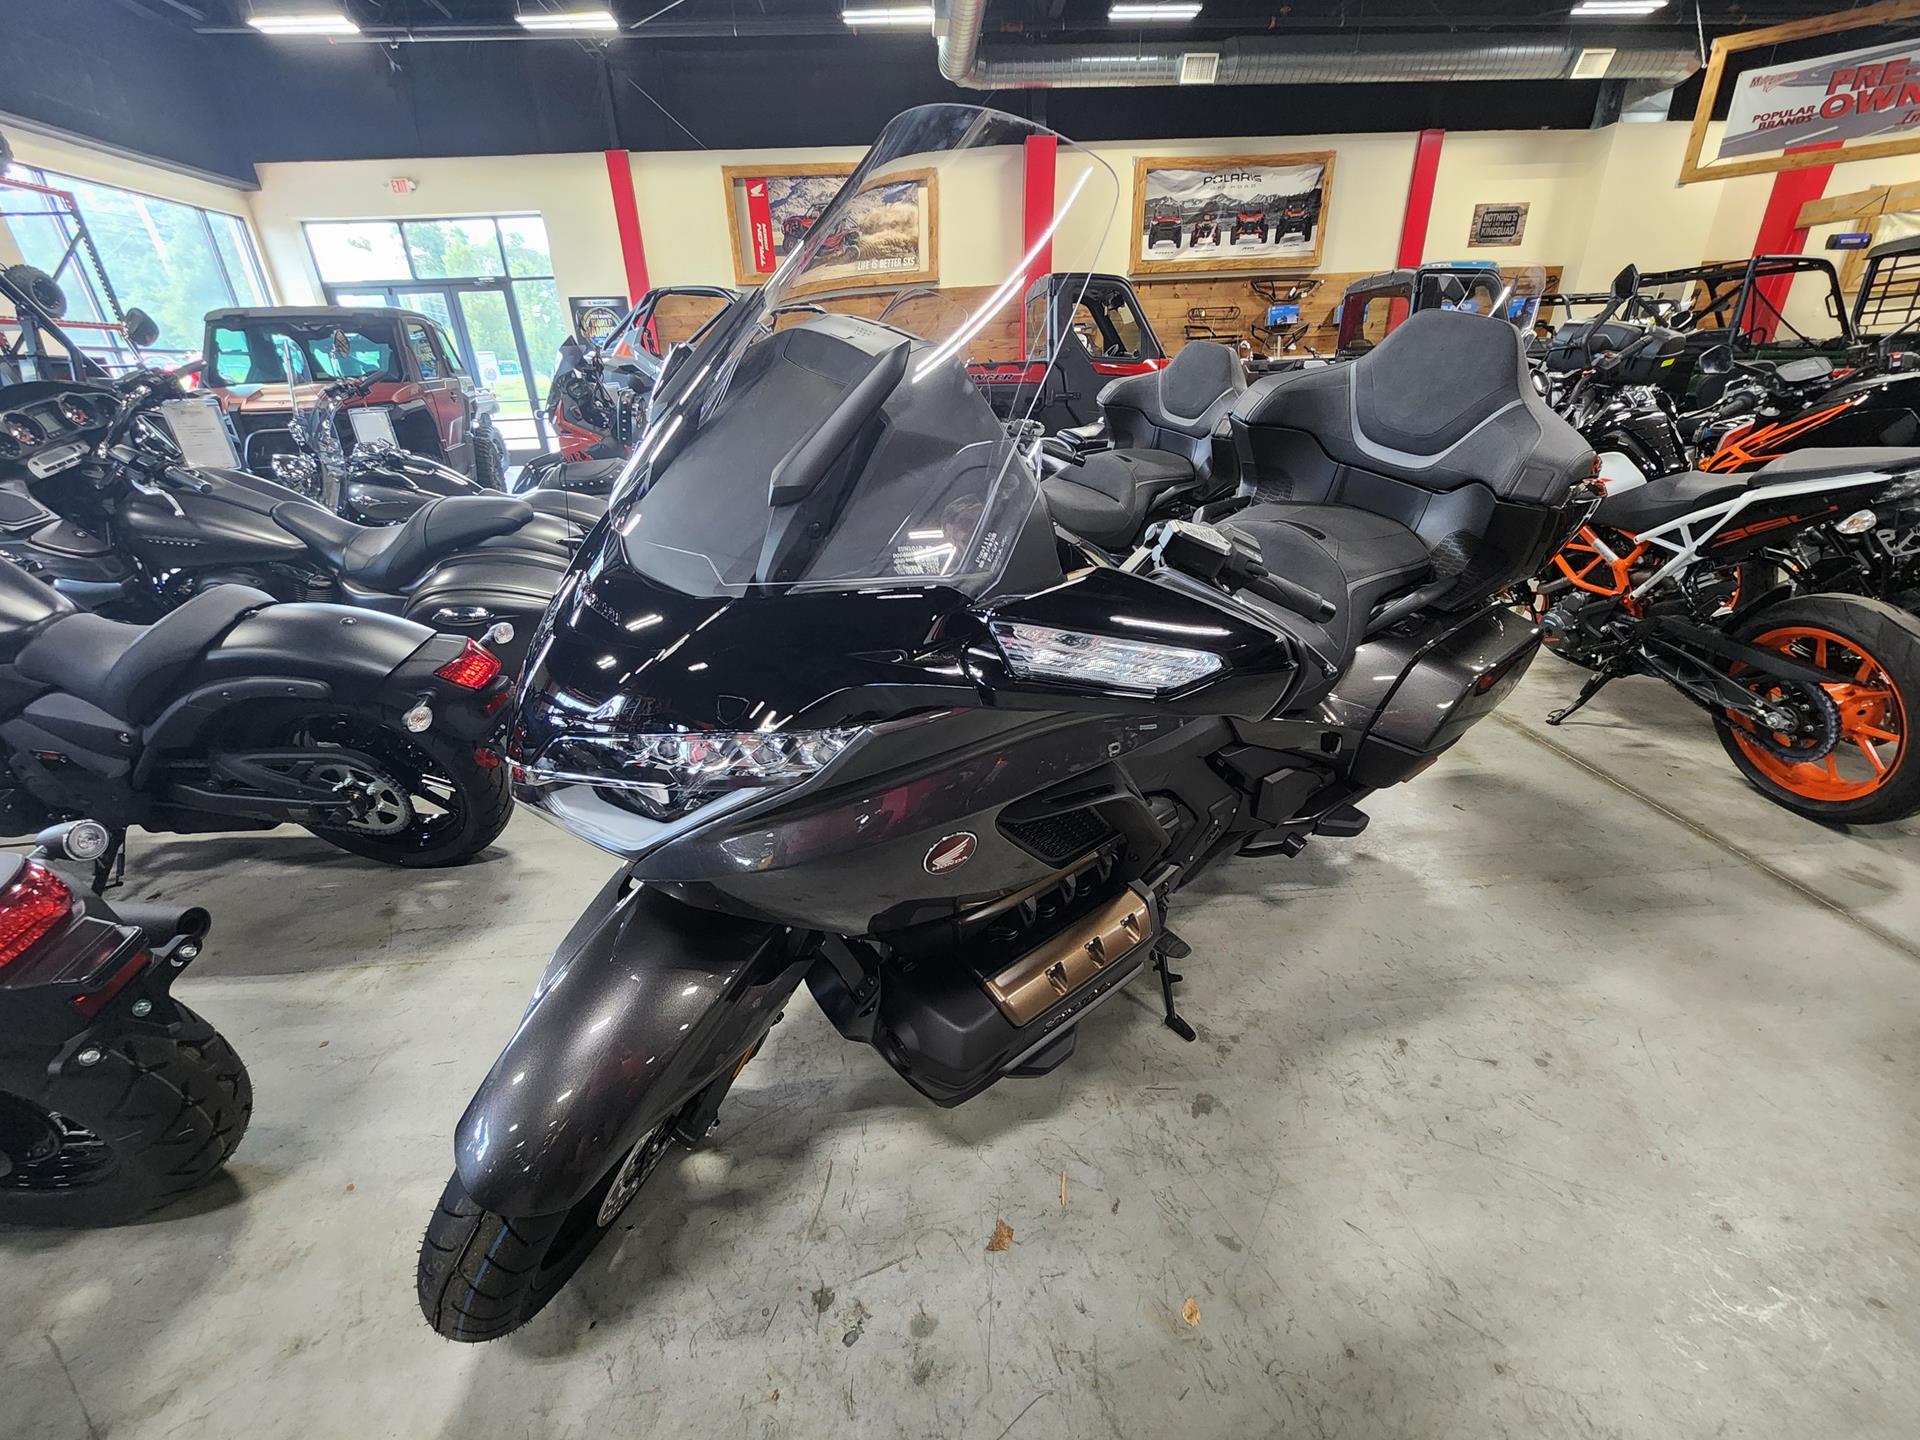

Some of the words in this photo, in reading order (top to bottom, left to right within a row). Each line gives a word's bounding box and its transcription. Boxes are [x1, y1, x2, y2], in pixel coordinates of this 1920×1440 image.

[1752, 105, 1816, 123] POPULAR
[1758, 114, 1812, 130] BRANDS
[1203, 172, 1262, 185] POLARIS
[391, 179, 408, 193] EXIT
[1483, 213, 1518, 222] NOTHING'S
[1480, 227, 1515, 236] KINGQUAD
[756, 223, 767, 267] TALON
[858, 260, 870, 270] LIFE
[871, 260, 878, 269] IS
[879, 257, 902, 269] BETTER
[902, 256, 915, 266] SXS
